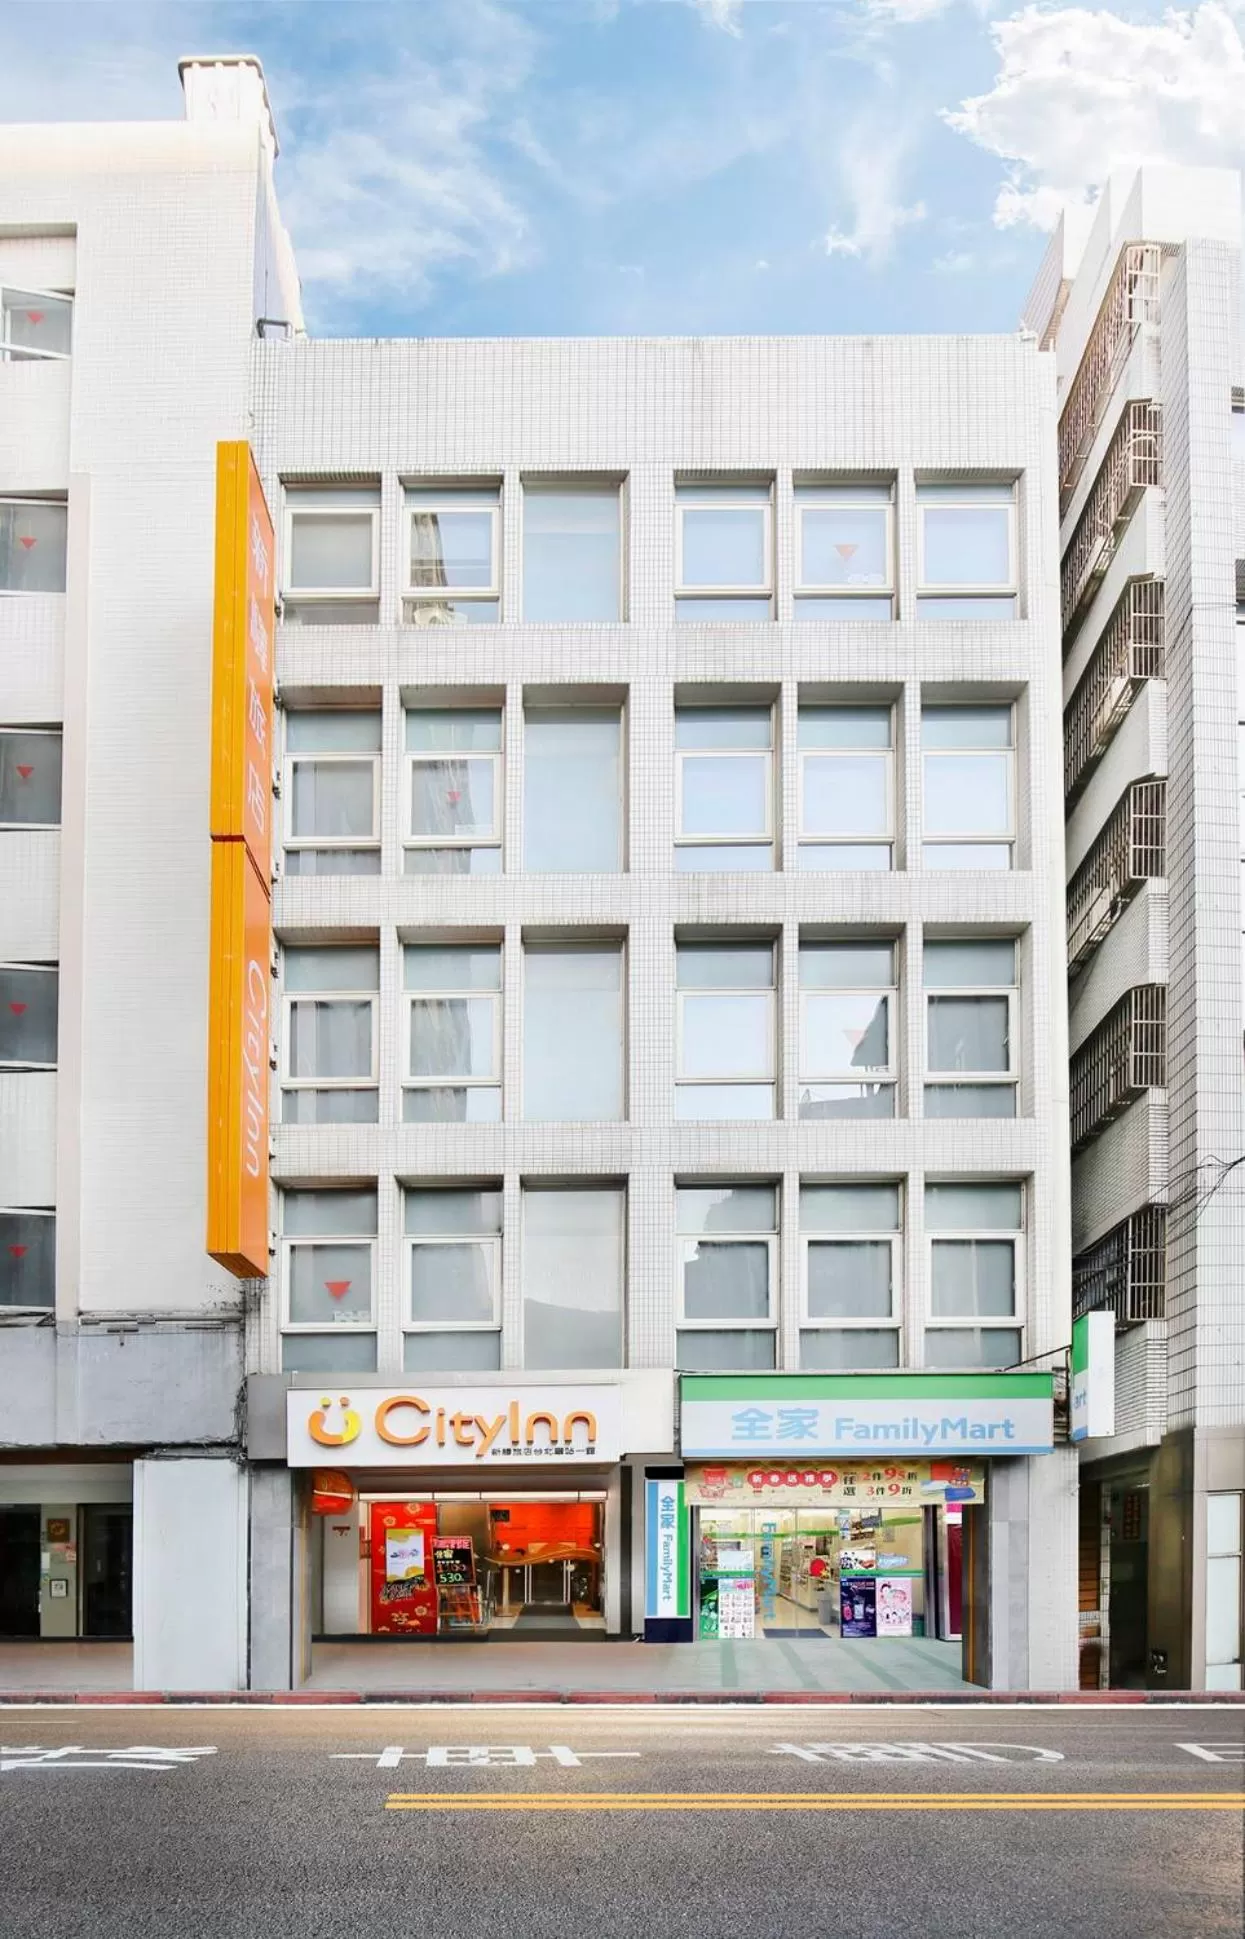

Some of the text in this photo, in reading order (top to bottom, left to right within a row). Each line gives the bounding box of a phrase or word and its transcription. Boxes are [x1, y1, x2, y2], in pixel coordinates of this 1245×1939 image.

[244, 959, 267, 1177] CityInn
[374, 1395, 597, 1457] CityInn
[731, 1407, 1016, 1446] 全家 FamilyMart
[660, 1495, 675, 1602] 全家 FamilyMart
